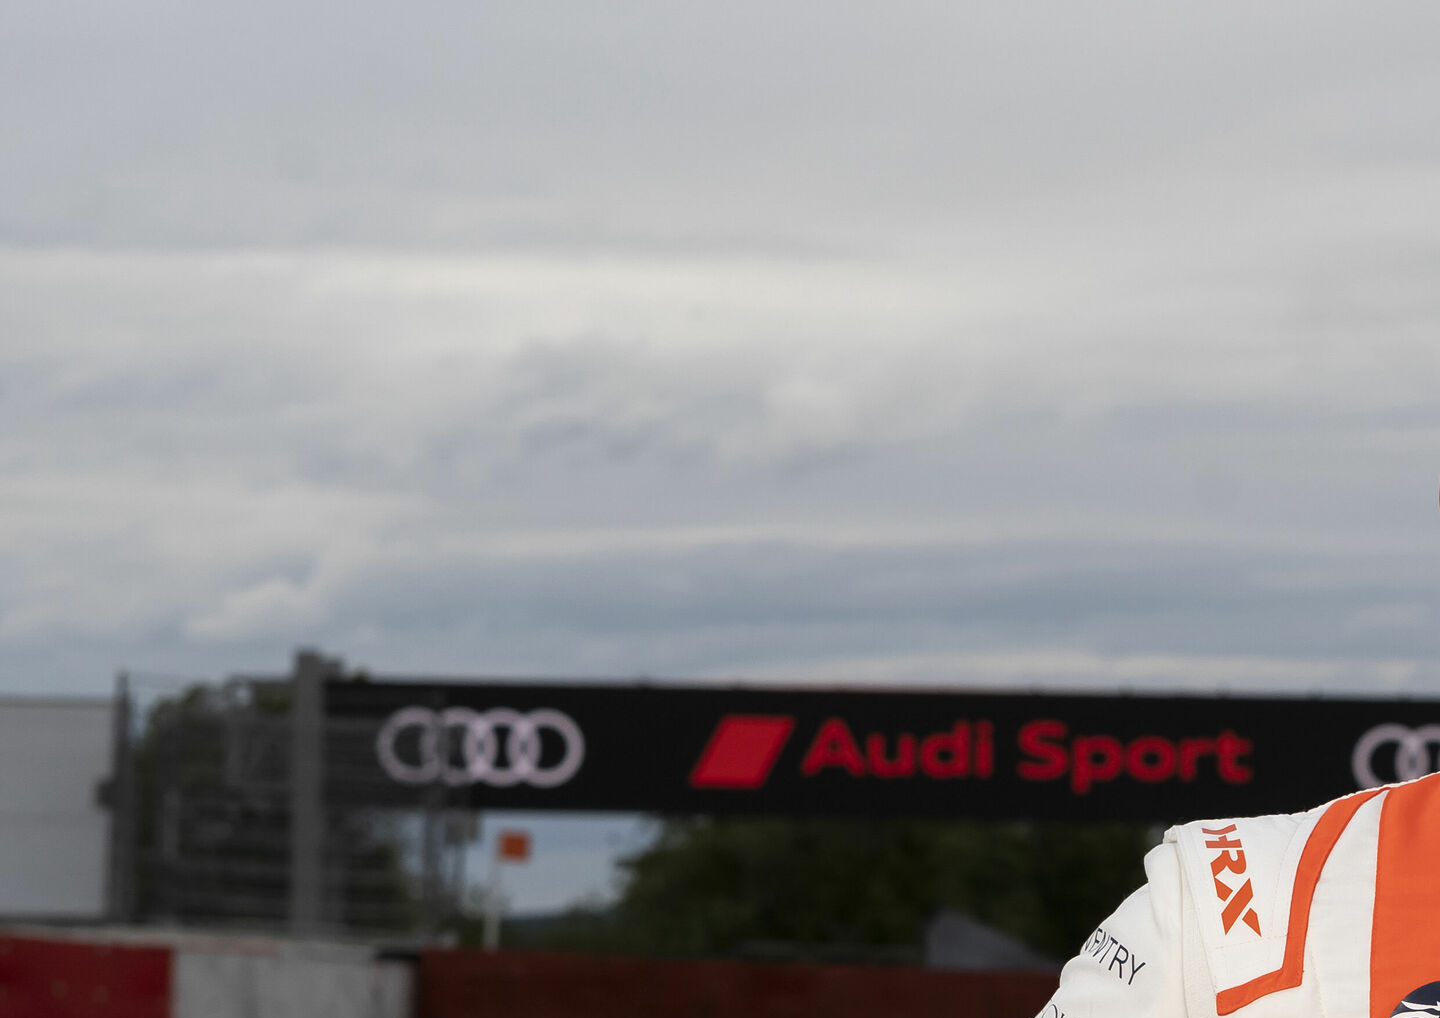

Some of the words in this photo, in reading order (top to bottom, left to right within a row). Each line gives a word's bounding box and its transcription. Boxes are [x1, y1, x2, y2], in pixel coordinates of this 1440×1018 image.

[801, 718, 994, 778] Audi
[1017, 720, 1253, 795] Sport
[1202, 824, 1262, 938] HRX
